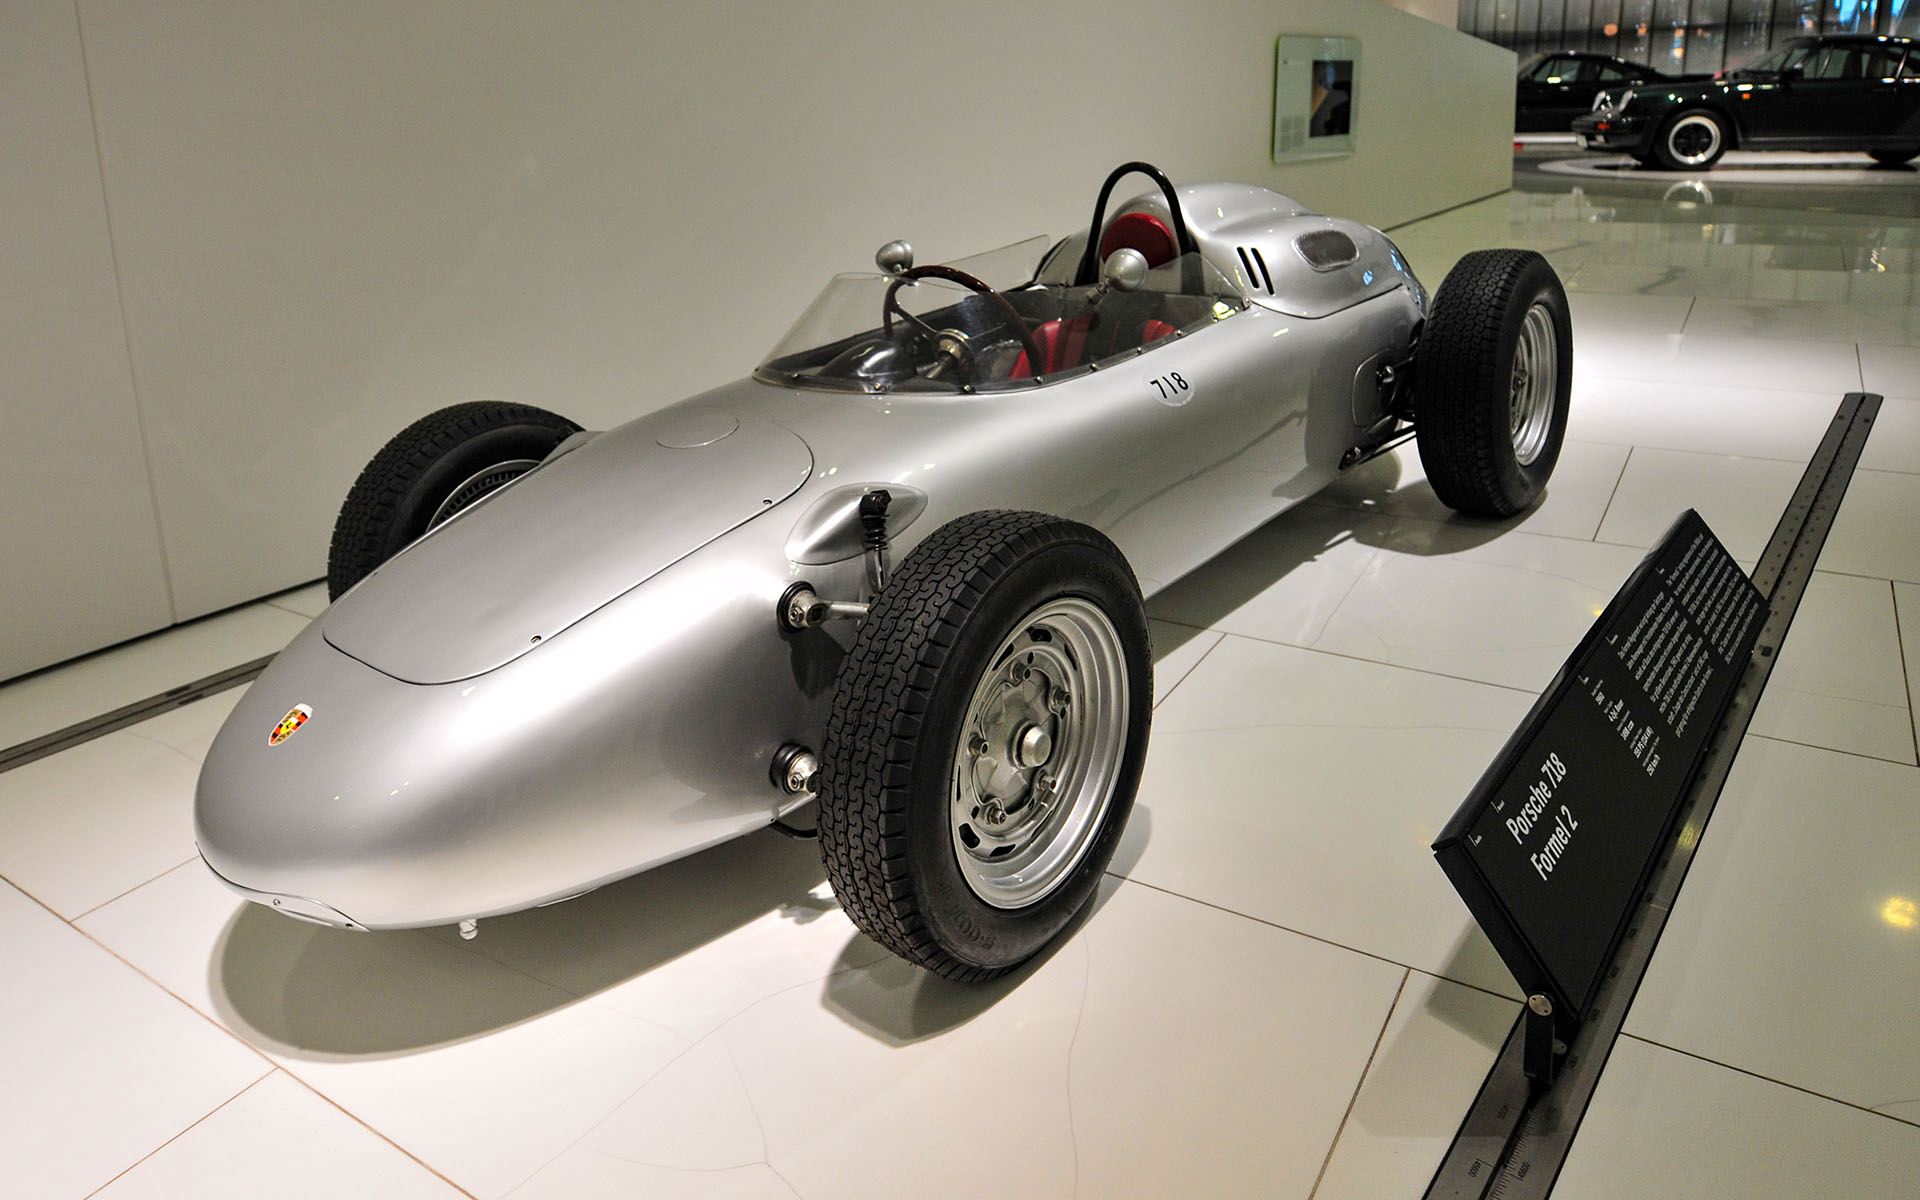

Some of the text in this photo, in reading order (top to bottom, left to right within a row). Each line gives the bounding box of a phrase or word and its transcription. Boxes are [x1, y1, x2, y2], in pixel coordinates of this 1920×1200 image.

[1149, 372, 1189, 399] 718
[1505, 752, 1567, 845] Porsche 718
[1530, 804, 1579, 881] Formel 2
